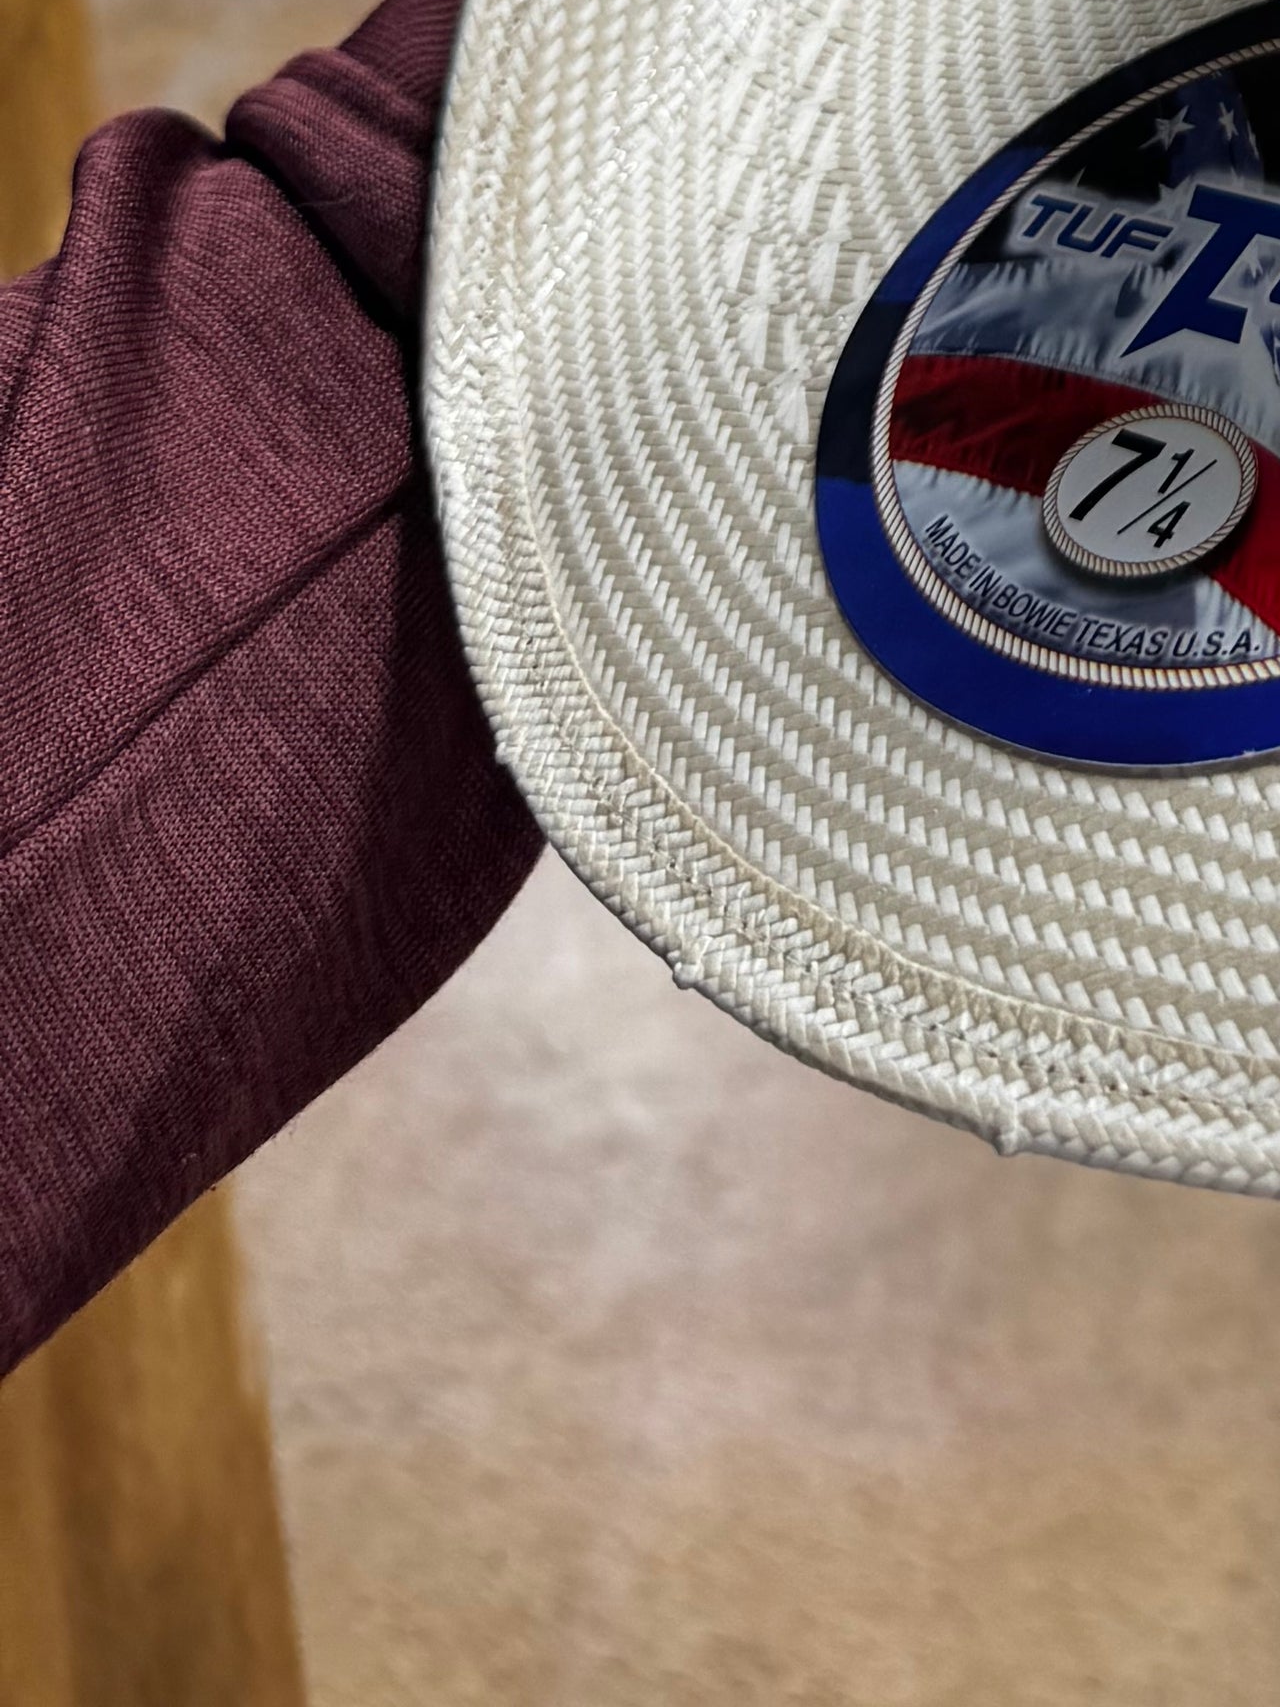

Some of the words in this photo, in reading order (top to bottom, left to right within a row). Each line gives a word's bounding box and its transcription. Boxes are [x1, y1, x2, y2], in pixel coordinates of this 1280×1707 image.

[1020, 191, 1175, 259] TUF
[1068, 428, 1168, 522] 7
[924, 513, 983, 580] MADE
[968, 564, 1004, 598] IN
[994, 584, 1078, 638] BOWIE
[1074, 616, 1169, 658] TEXAS
[1172, 629, 1262, 659] U.S.A.
